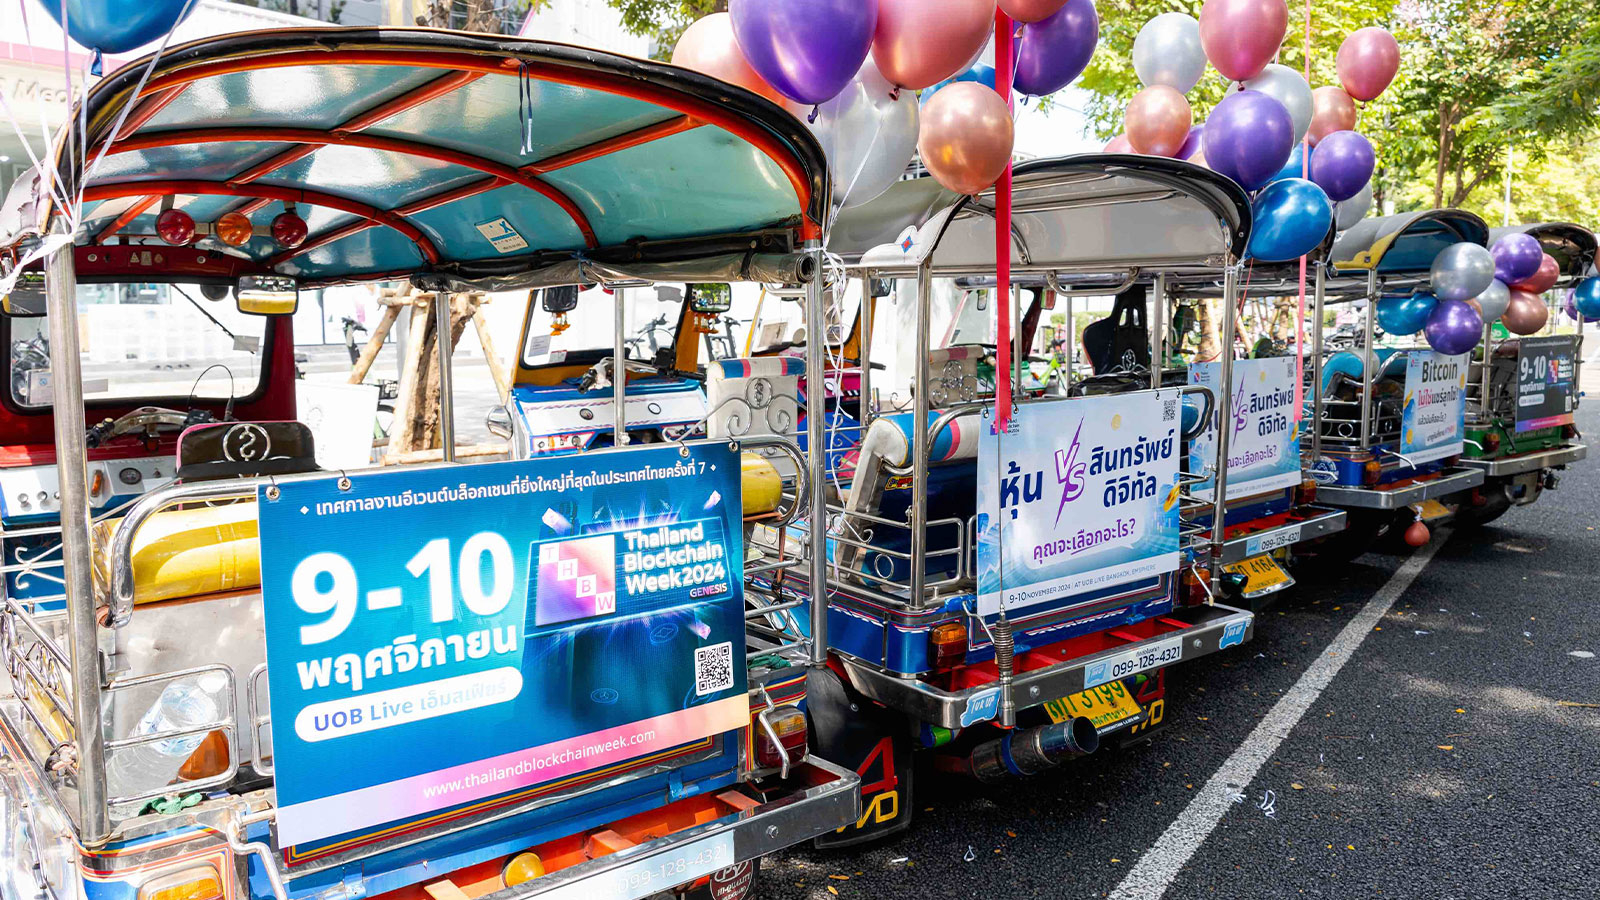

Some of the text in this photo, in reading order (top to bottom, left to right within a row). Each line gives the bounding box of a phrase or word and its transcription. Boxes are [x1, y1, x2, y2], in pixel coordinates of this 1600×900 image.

[1421, 359, 1458, 383] Bitcoin
[1520, 355, 1546, 381] 9-10
[1249, 383, 1295, 414] สินทรัพย์
[1258, 412, 1287, 437] ดิจิทัล
[1089, 429, 1175, 476] สินทรัพย์
[1227, 444, 1278, 470] ณจะเลือกอะไร?
[315, 458, 706, 516] เทศกาลงานอีเวนต์บล็อกเชนที่ยิ่งใหญ่ที่สุดในประเทศไทยครั้งที่ 7
[1054, 442, 1087, 503] VS
[1000, 461, 1043, 519] หุ้น
[1103, 471, 1157, 507] ดิจิทัล
[623, 521, 704, 551] Thailand
[1033, 518, 1136, 564] คุณจะเลือกอะไร?
[623, 541, 723, 573] Blockchain
[1249, 557, 1277, 575] 4164
[291, 531, 515, 646] 9-10
[689, 582, 728, 599] GENESIS
[1057, 583, 1071, 592] 2024
[296, 624, 518, 691] พฤศจิกายน
[1112, 646, 1180, 677] 099-128-4321
[314, 708, 363, 732] UOB
[370, 701, 414, 721] Live
[423, 729, 656, 798] www.thailandblockchainweek.com
[616, 843, 728, 894] 099-128-4321
